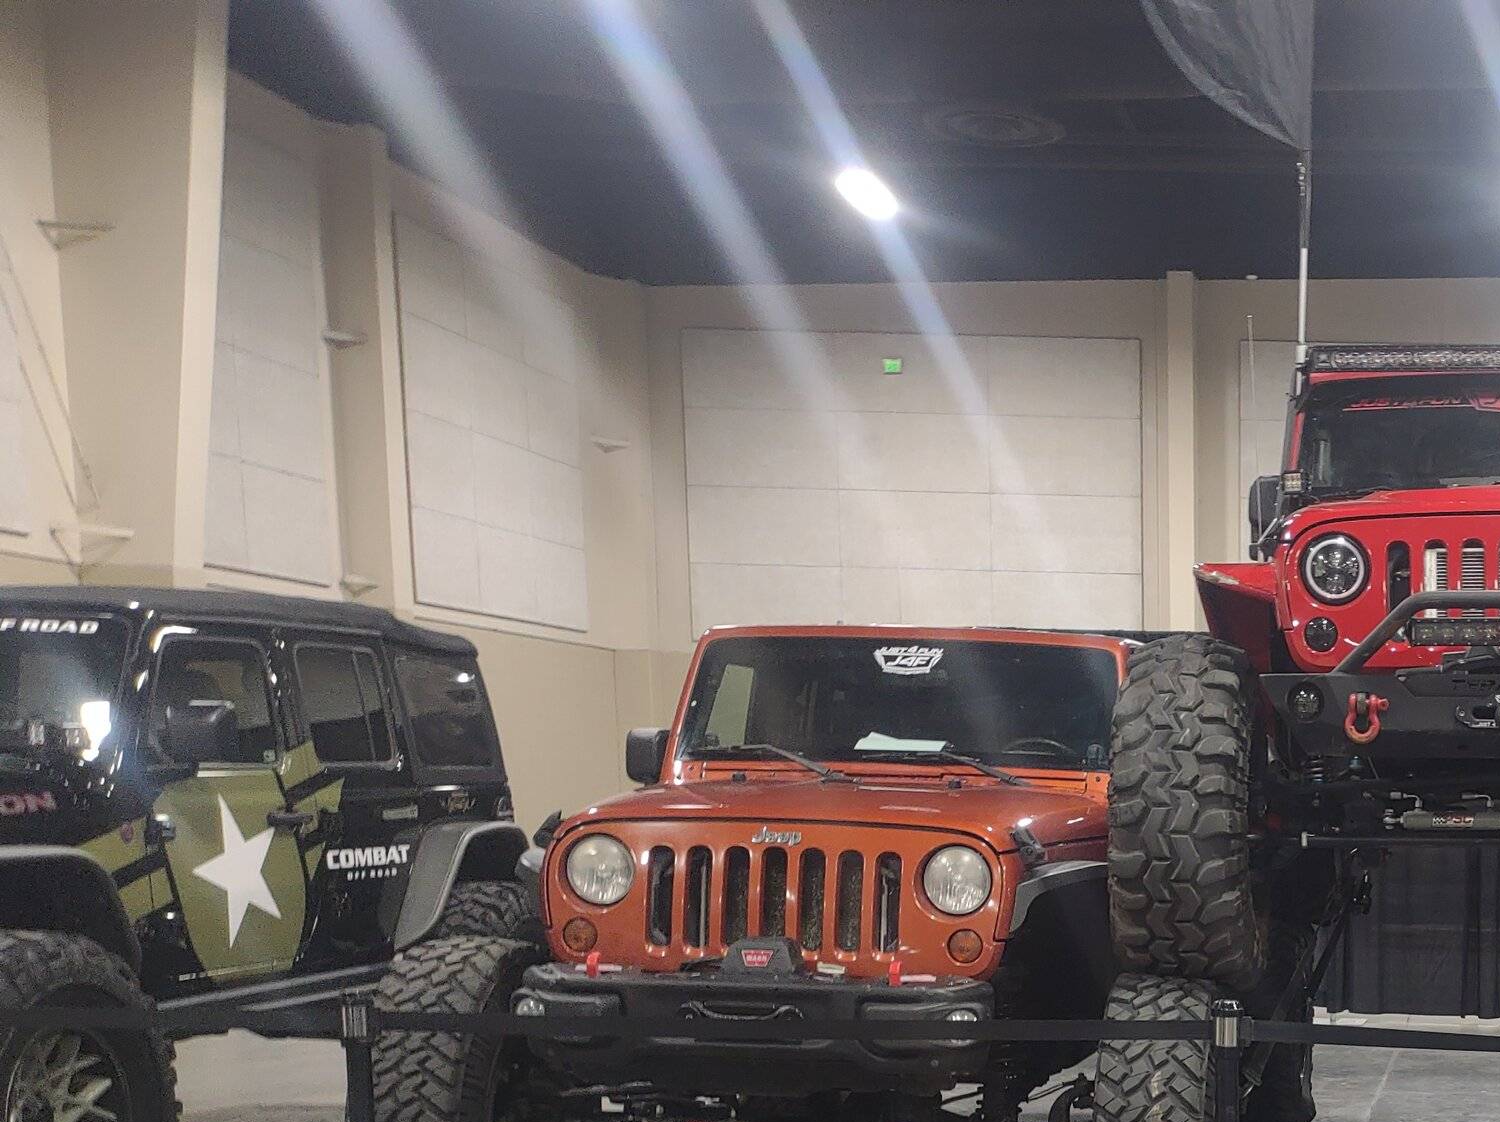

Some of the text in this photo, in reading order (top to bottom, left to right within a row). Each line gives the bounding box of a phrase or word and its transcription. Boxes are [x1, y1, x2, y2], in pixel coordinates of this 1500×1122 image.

[20, 618, 100, 635] ROAD
[885, 656, 931, 667] J4F
[751, 825, 802, 847] Jeep
[326, 844, 410, 870] COMBAT
[370, 867, 398, 879] ROAD
